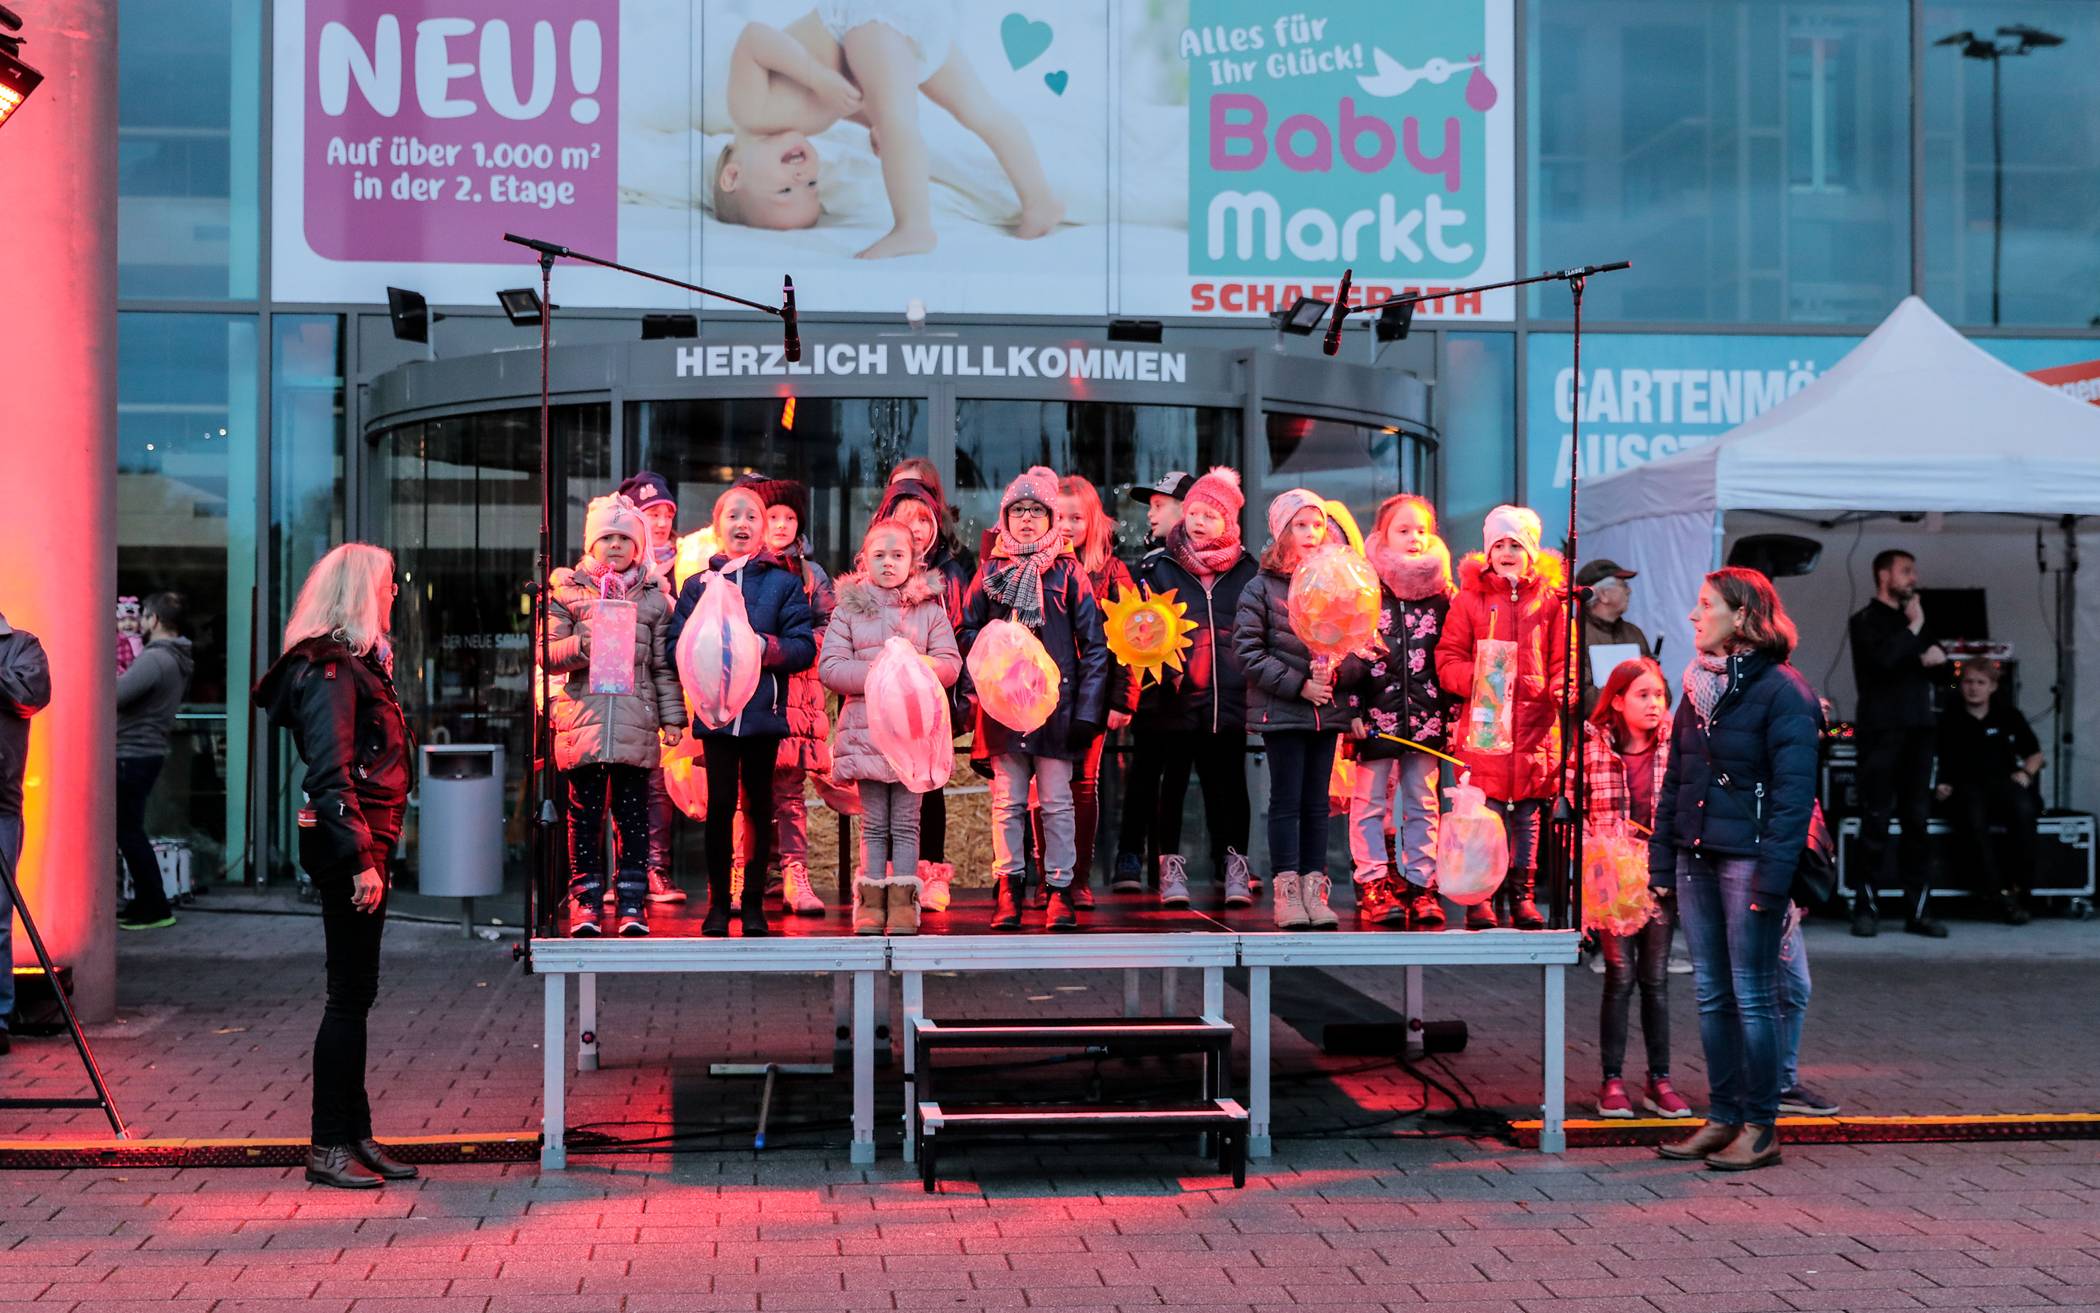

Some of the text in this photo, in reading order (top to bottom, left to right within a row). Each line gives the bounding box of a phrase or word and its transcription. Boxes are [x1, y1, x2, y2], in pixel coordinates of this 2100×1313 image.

[1180, 13, 1328, 58] Alles für
[318, 13, 602, 124] NEU!
[1208, 43, 1364, 86] Ihr Glück!
[327, 136, 383, 167] Auf
[389, 136, 462, 167] über
[472, 142, 554, 169] 1.000
[1209, 92, 1461, 193] Baby
[353, 170, 575, 209] in der 2. Etage
[676, 343, 1187, 383] HERZLICH WILLKOMMEN
[1554, 360, 1833, 424] GARTENMÖ
